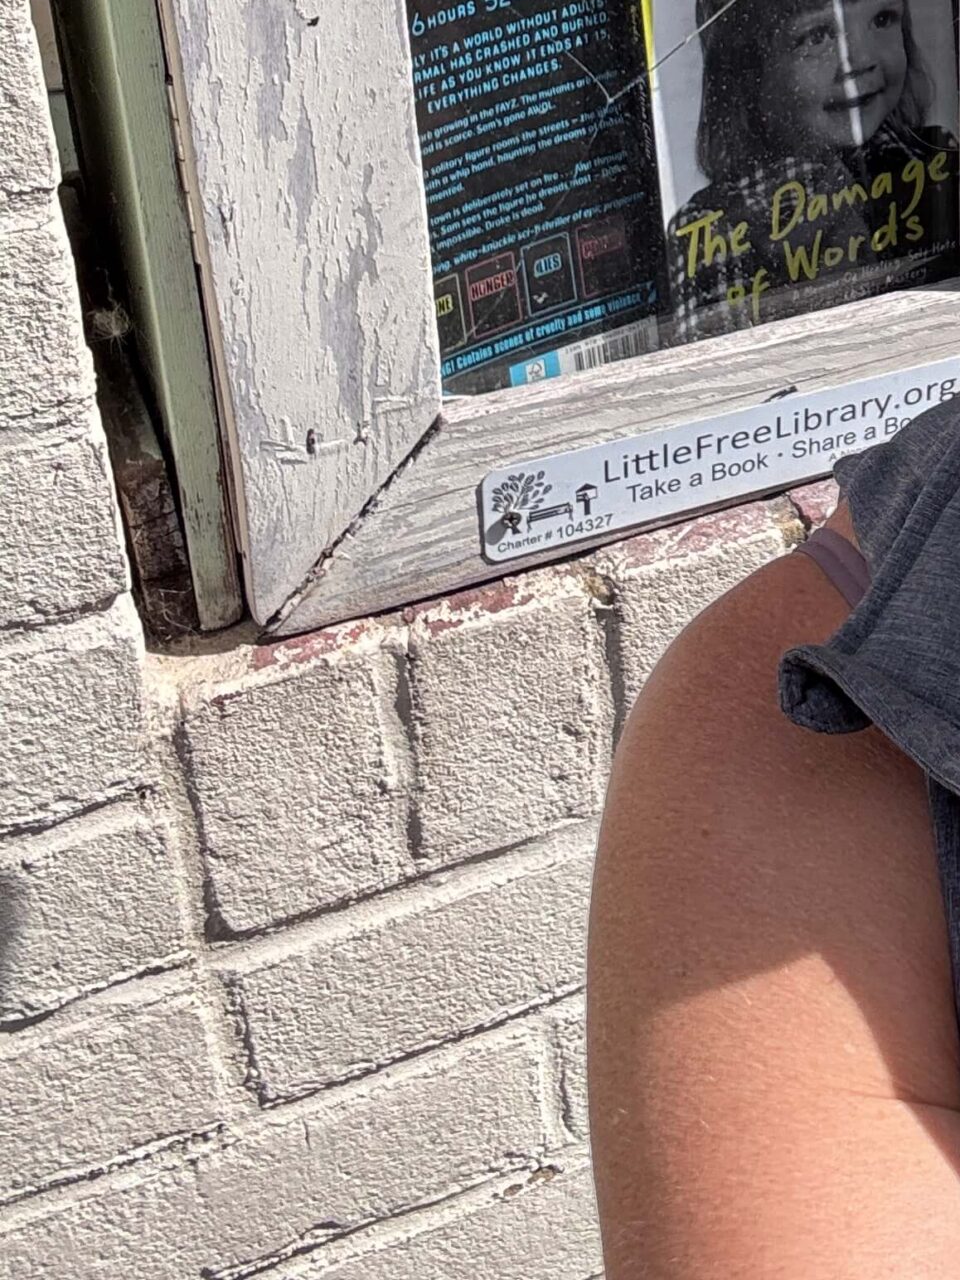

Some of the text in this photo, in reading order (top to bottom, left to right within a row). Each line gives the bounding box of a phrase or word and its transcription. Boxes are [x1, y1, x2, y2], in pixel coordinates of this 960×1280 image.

[427, 0, 476, 30] HOURS
[431, 45, 449, 62] IT'S
[453, 42, 461, 54] A
[463, 27, 503, 49] WORLD
[506, 9, 558, 35] WITHOUT
[414, 83, 436, 103] IFE
[441, 74, 456, 92] AS
[459, 66, 482, 84] YOU
[486, 53, 522, 74] KNOW
[526, 49, 537, 62] IT
[540, 38, 572, 57] ENDS
[450, 55, 473, 74] HAS
[475, 34, 530, 62] CRASHED
[534, 26, 558, 43] AND
[427, 58, 562, 114] EVERYTHING CHANGES.
[434, 117, 469, 138] growing
[470, 113, 479, 122] in
[479, 108, 494, 120] the
[522, 93, 537, 105] The
[538, 82, 575, 99] mutants
[431, 157, 463, 176] solitary
[464, 145, 491, 162] figure
[521, 129, 537, 141] the
[538, 120, 570, 137] streets
[435, 141, 443, 151] is
[476, 118, 502, 135] Sam's
[504, 110, 526, 127] gone
[449, 167, 470, 182] whip
[497, 143, 536, 165] haunting
[537, 138, 552, 150] the
[554, 128, 587, 145] dreams
[430, 211, 452, 226] town
[462, 188, 513, 214] deliberately
[515, 181, 529, 194] set
[530, 177, 542, 188] on
[440, 222, 460, 236] Sam
[461, 213, 482, 227] sees
[482, 206, 498, 218] the
[498, 195, 525, 211] figure
[525, 191, 537, 204] he
[538, 183, 569, 199] dreads
[570, 174, 592, 188] most
[485, 214, 511, 231] Drake
[512, 211, 520, 221] is
[521, 202, 545, 218] dead.
[675, 151, 952, 280] The Damage
[454, 233, 516, 265] white-knuckle
[541, 214, 572, 230] thriller
[572, 209, 582, 221] of
[725, 201, 925, 327] of Words
[456, 345, 493, 370] Contains
[493, 334, 524, 353] scenes
[525, 327, 535, 342] of
[535, 317, 566, 338] cruelty
[567, 309, 583, 326] and
[584, 304, 607, 321] some
[626, 474, 682, 505] Take
[690, 470, 702, 487] a
[711, 452, 769, 483] Book
[791, 430, 857, 459] Share
[864, 425, 877, 441] a
[497, 513, 614, 553] Charter # 104327
